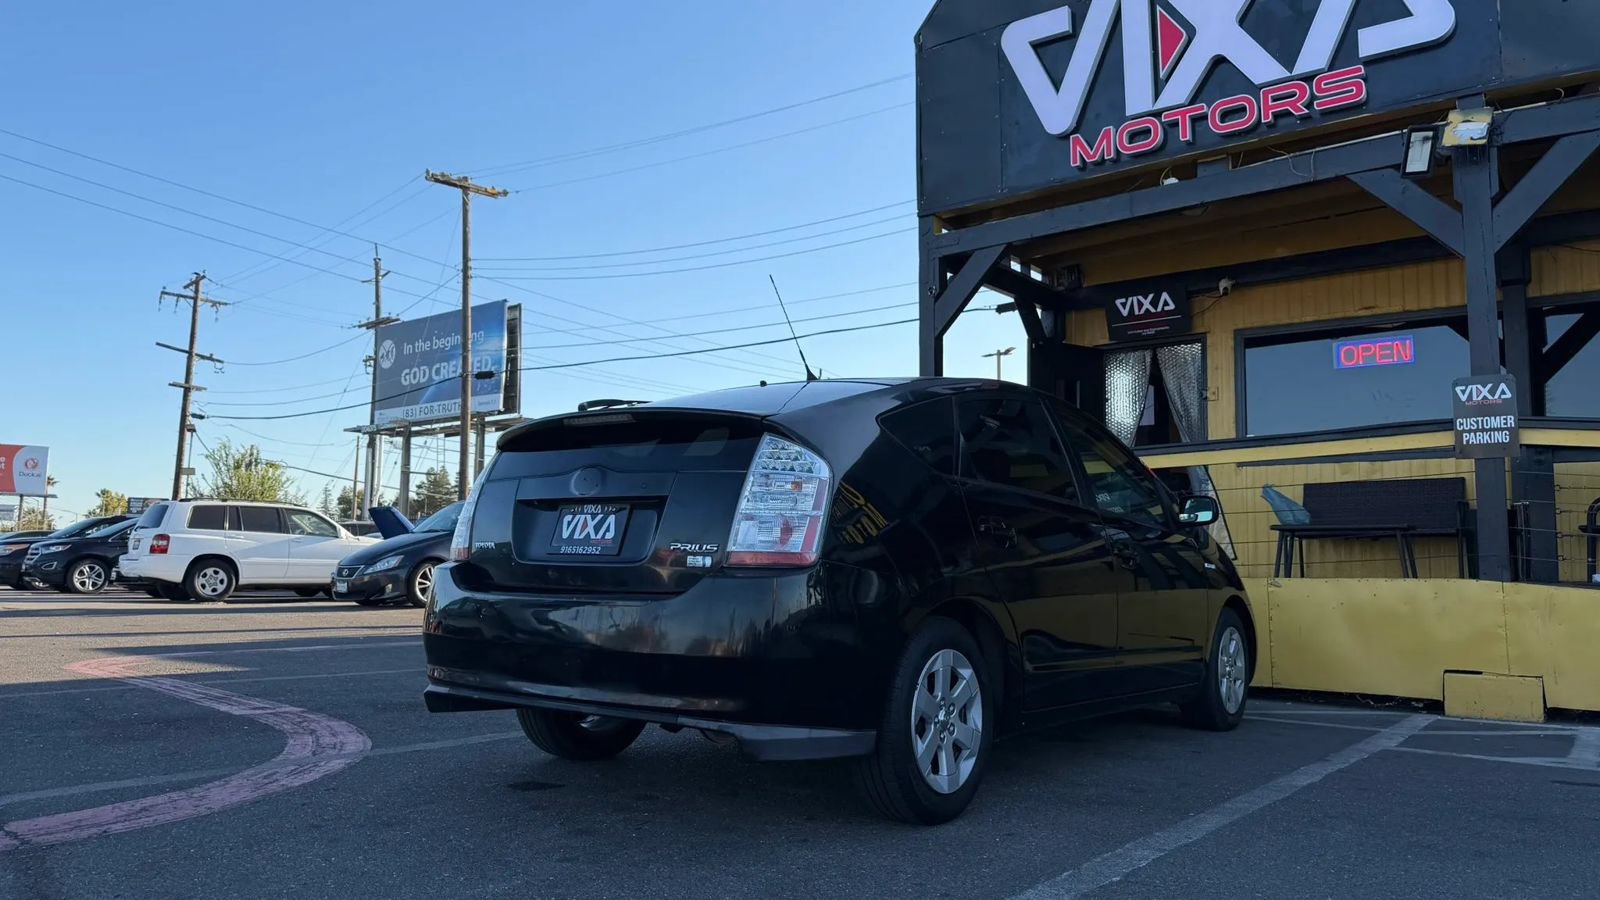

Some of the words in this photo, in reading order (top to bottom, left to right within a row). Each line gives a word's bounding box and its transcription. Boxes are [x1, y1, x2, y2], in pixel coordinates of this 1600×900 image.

[1001, 0, 1456, 136] VIXA
[1069, 64, 1367, 168] MOTORS
[1114, 291, 1176, 317] VIXA
[403, 343, 413, 354] In
[415, 339, 431, 352] the
[432, 330, 484, 351] beginng
[1341, 340, 1411, 366] OPEN
[401, 366, 429, 385] GOD
[1455, 383, 1512, 401] VIXA
[402, 408, 417, 418] (83)
[1456, 415, 1515, 430] CUSTOMER
[1462, 430, 1510, 444] PARKING
[583, 504, 602, 513] VIXA
[562, 514, 616, 539] VIXA
[560, 546, 601, 554] 9165162952
[670, 543, 719, 552] PRIUS
